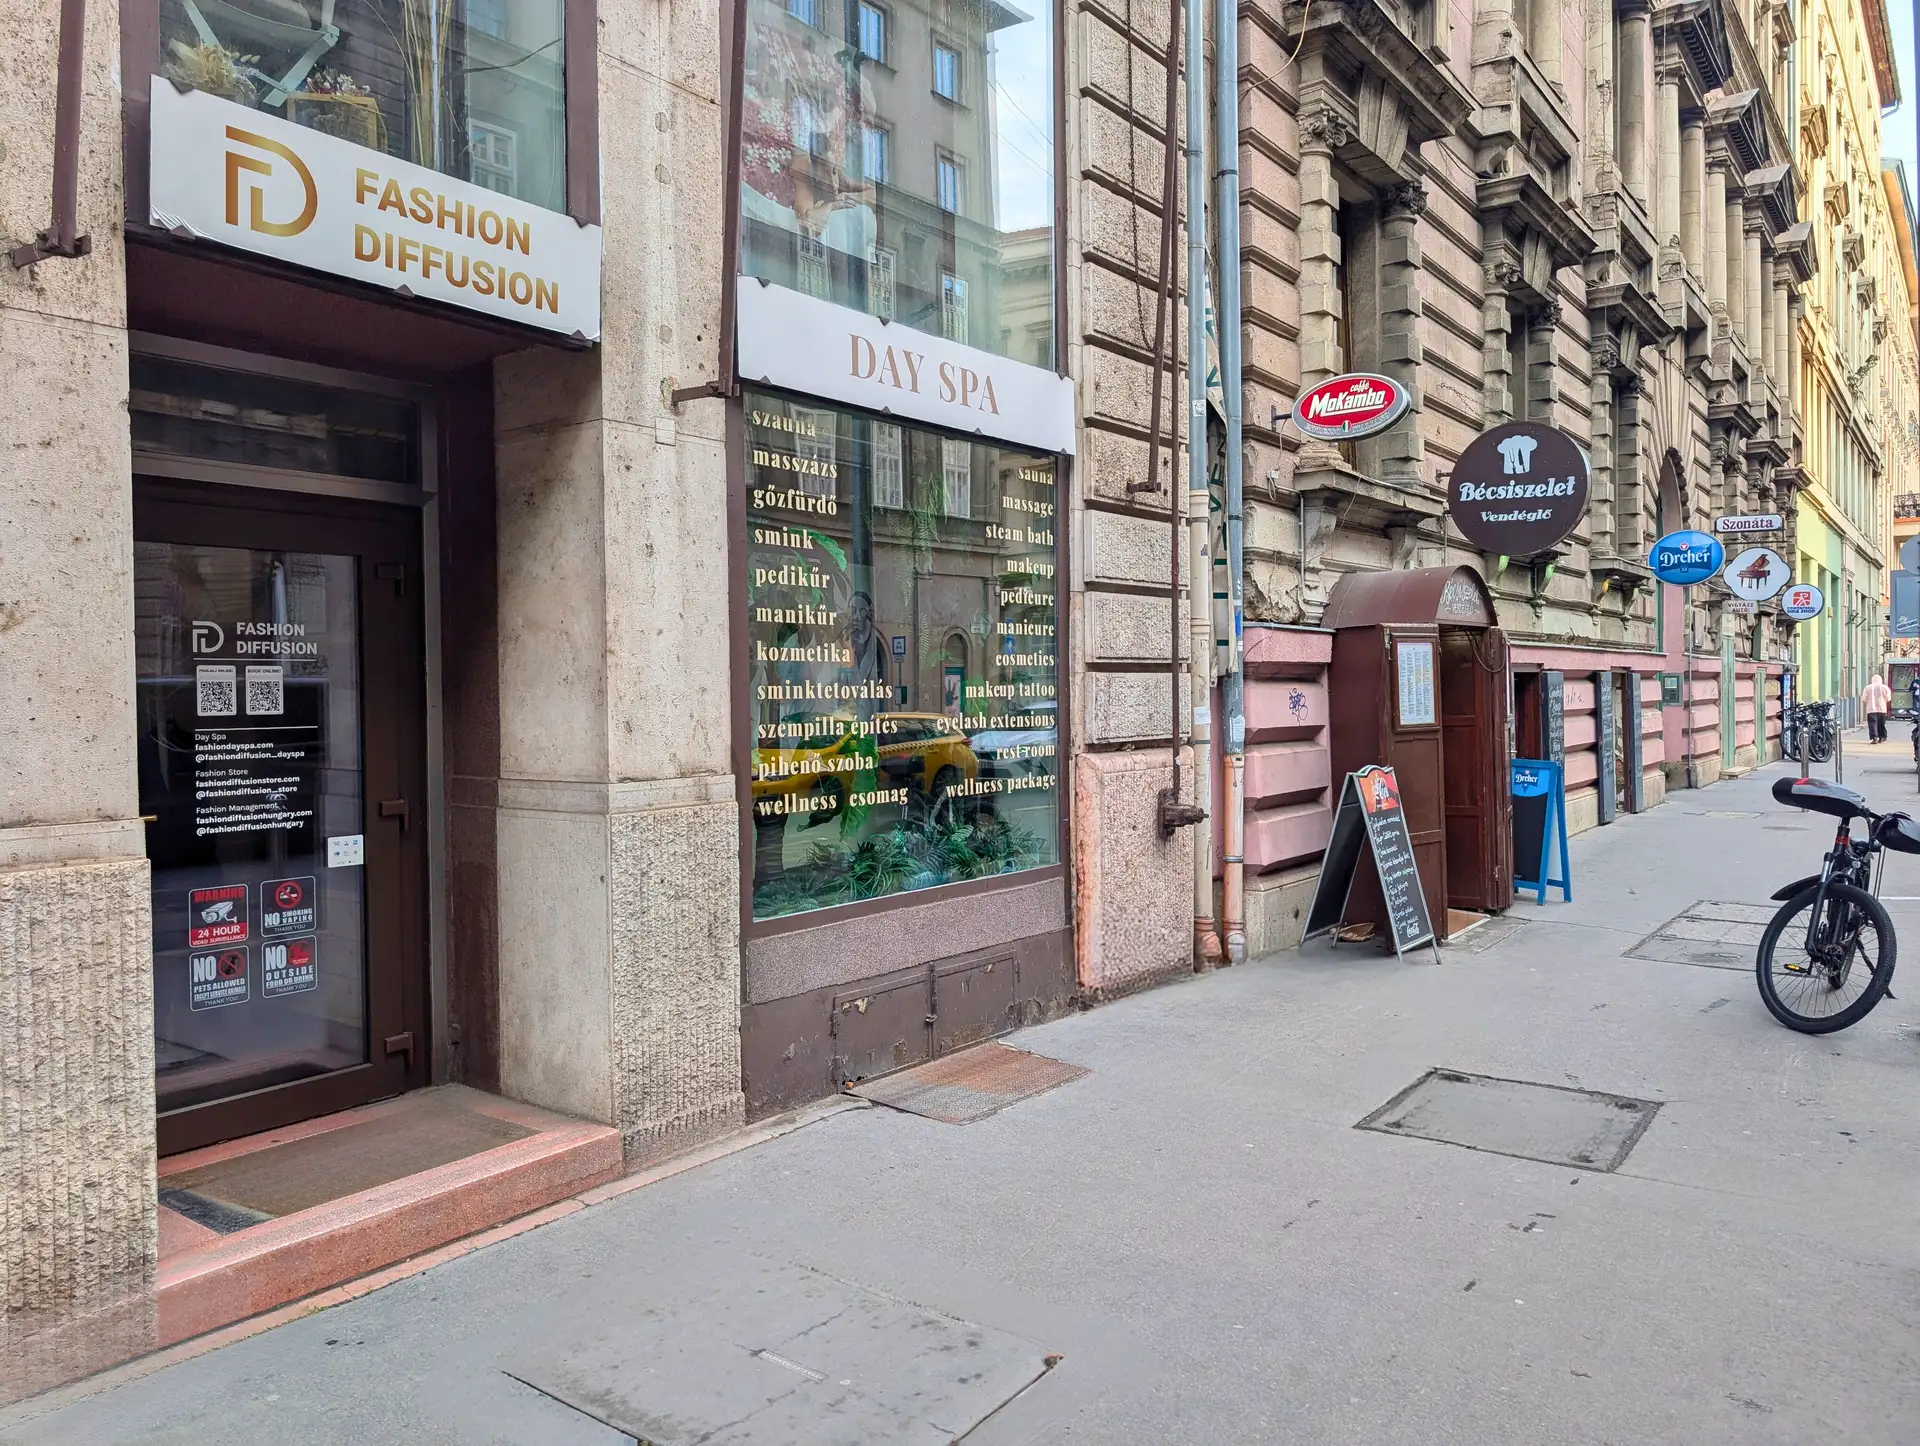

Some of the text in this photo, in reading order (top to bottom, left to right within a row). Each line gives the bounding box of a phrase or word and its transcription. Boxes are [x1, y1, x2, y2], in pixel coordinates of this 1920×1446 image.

[355, 168, 531, 255] FASHION
[354, 224, 559, 314] DIFFUSION
[849, 332, 1000, 416] DAY SPA
[752, 410, 816, 437] szauna
[753, 449, 838, 479] masszázs
[1018, 467, 1053, 485] sauna
[1460, 476, 1576, 501] Bécsiszelet
[753, 484, 837, 516] gőzfürdő
[1002, 495, 1054, 518] massage
[1480, 508, 1552, 522] Vendéglő
[1722, 517, 1774, 530] Szonáta
[754, 526, 814, 550] smink
[985, 524, 1054, 546] steam bath
[1660, 549, 1710, 567] Dreher
[755, 564, 830, 588] pedikűr
[1006, 557, 1054, 579] makeup
[1000, 588, 1054, 606] pedicure
[755, 604, 837, 626] manikűr
[236, 622, 304, 636] FASHION
[996, 619, 1055, 637] manicure
[236, 641, 317, 655] DIFFUSION
[756, 640, 851, 662] kozmetika
[995, 650, 1055, 667] cosmetics
[757, 679, 893, 700] sminktetoválás
[965, 681, 1055, 700] makeup tattoo
[758, 714, 898, 740] szempilla építés
[937, 711, 1055, 734] eyelash extensions
[195, 733, 227, 742] Day Spa
[195, 742, 274, 751] fashiondayspa.com
[195, 751, 305, 763] @fashiondiffusion_dayspa
[996, 744, 1055, 760] rest room
[758, 752, 874, 782] pihenő szoba
[196, 776, 300, 788] fashiondiffusionstore.com
[946, 772, 1056, 798] wellness package
[1515, 774, 1538, 783] Dreher
[196, 786, 298, 800] @fashiondiffusion_store
[758, 787, 908, 816] wellness csomag
[196, 803, 278, 814] Fashion Management
[196, 810, 313, 824] fashiondiffusionhungary.com
[196, 821, 304, 836] @fashiondiffusionhungary
[193, 887, 245, 903] WARNING
[264, 907, 313, 927] NO SMOKING
[282, 914, 313, 923] VAPING
[197, 925, 241, 939] 24 HOUR
[274, 923, 306, 933] THANK YOU
[265, 945, 287, 971] NO
[193, 956, 217, 983] NO
[266, 965, 314, 981] OUTSIDE
[193, 977, 245, 993] PETS ALLOWED
[266, 979, 283, 988] FOOD
[293, 973, 314, 983] DRINK
[204, 998, 225, 1006] THANK
